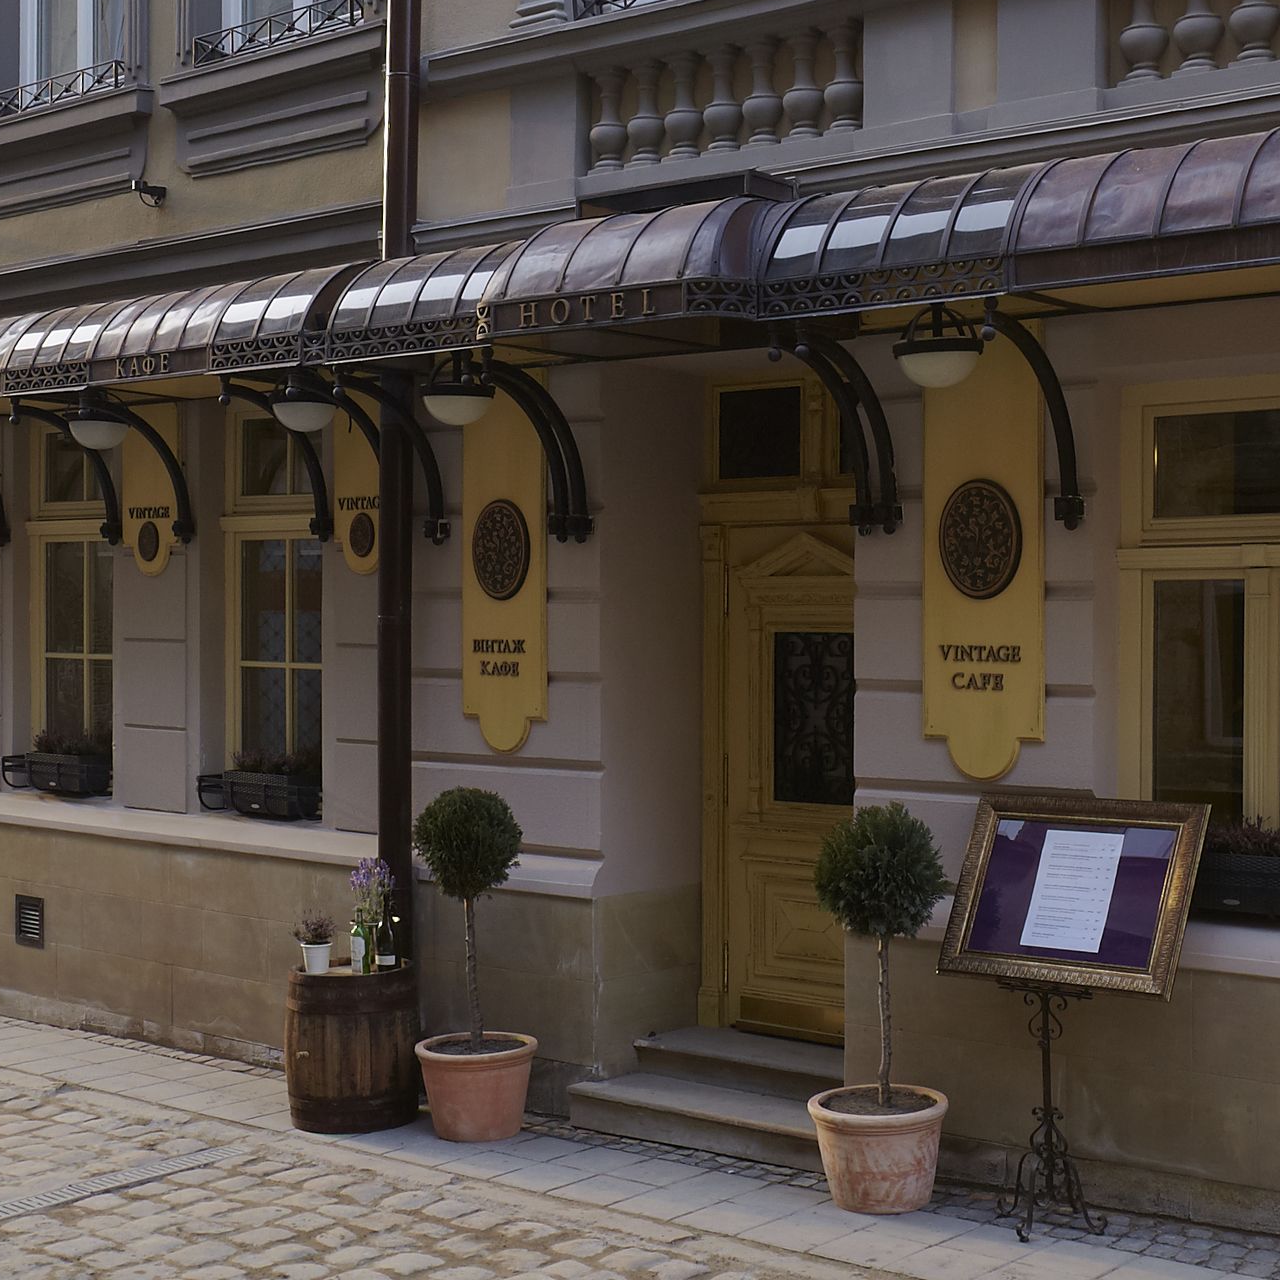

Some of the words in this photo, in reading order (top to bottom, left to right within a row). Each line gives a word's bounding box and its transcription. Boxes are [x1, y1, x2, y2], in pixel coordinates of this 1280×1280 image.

[519, 288, 656, 328] HOTEL
[115, 352, 170, 379] КАФЕ
[128, 506, 170, 519] VINTAGE
[338, 496, 380, 511] VINTAG
[472, 639, 526, 654] ВІНТАЖ
[939, 644, 1022, 663] VINTAGE
[480, 660, 520, 677] КАФЕ
[951, 671, 1004, 692] CAFE
